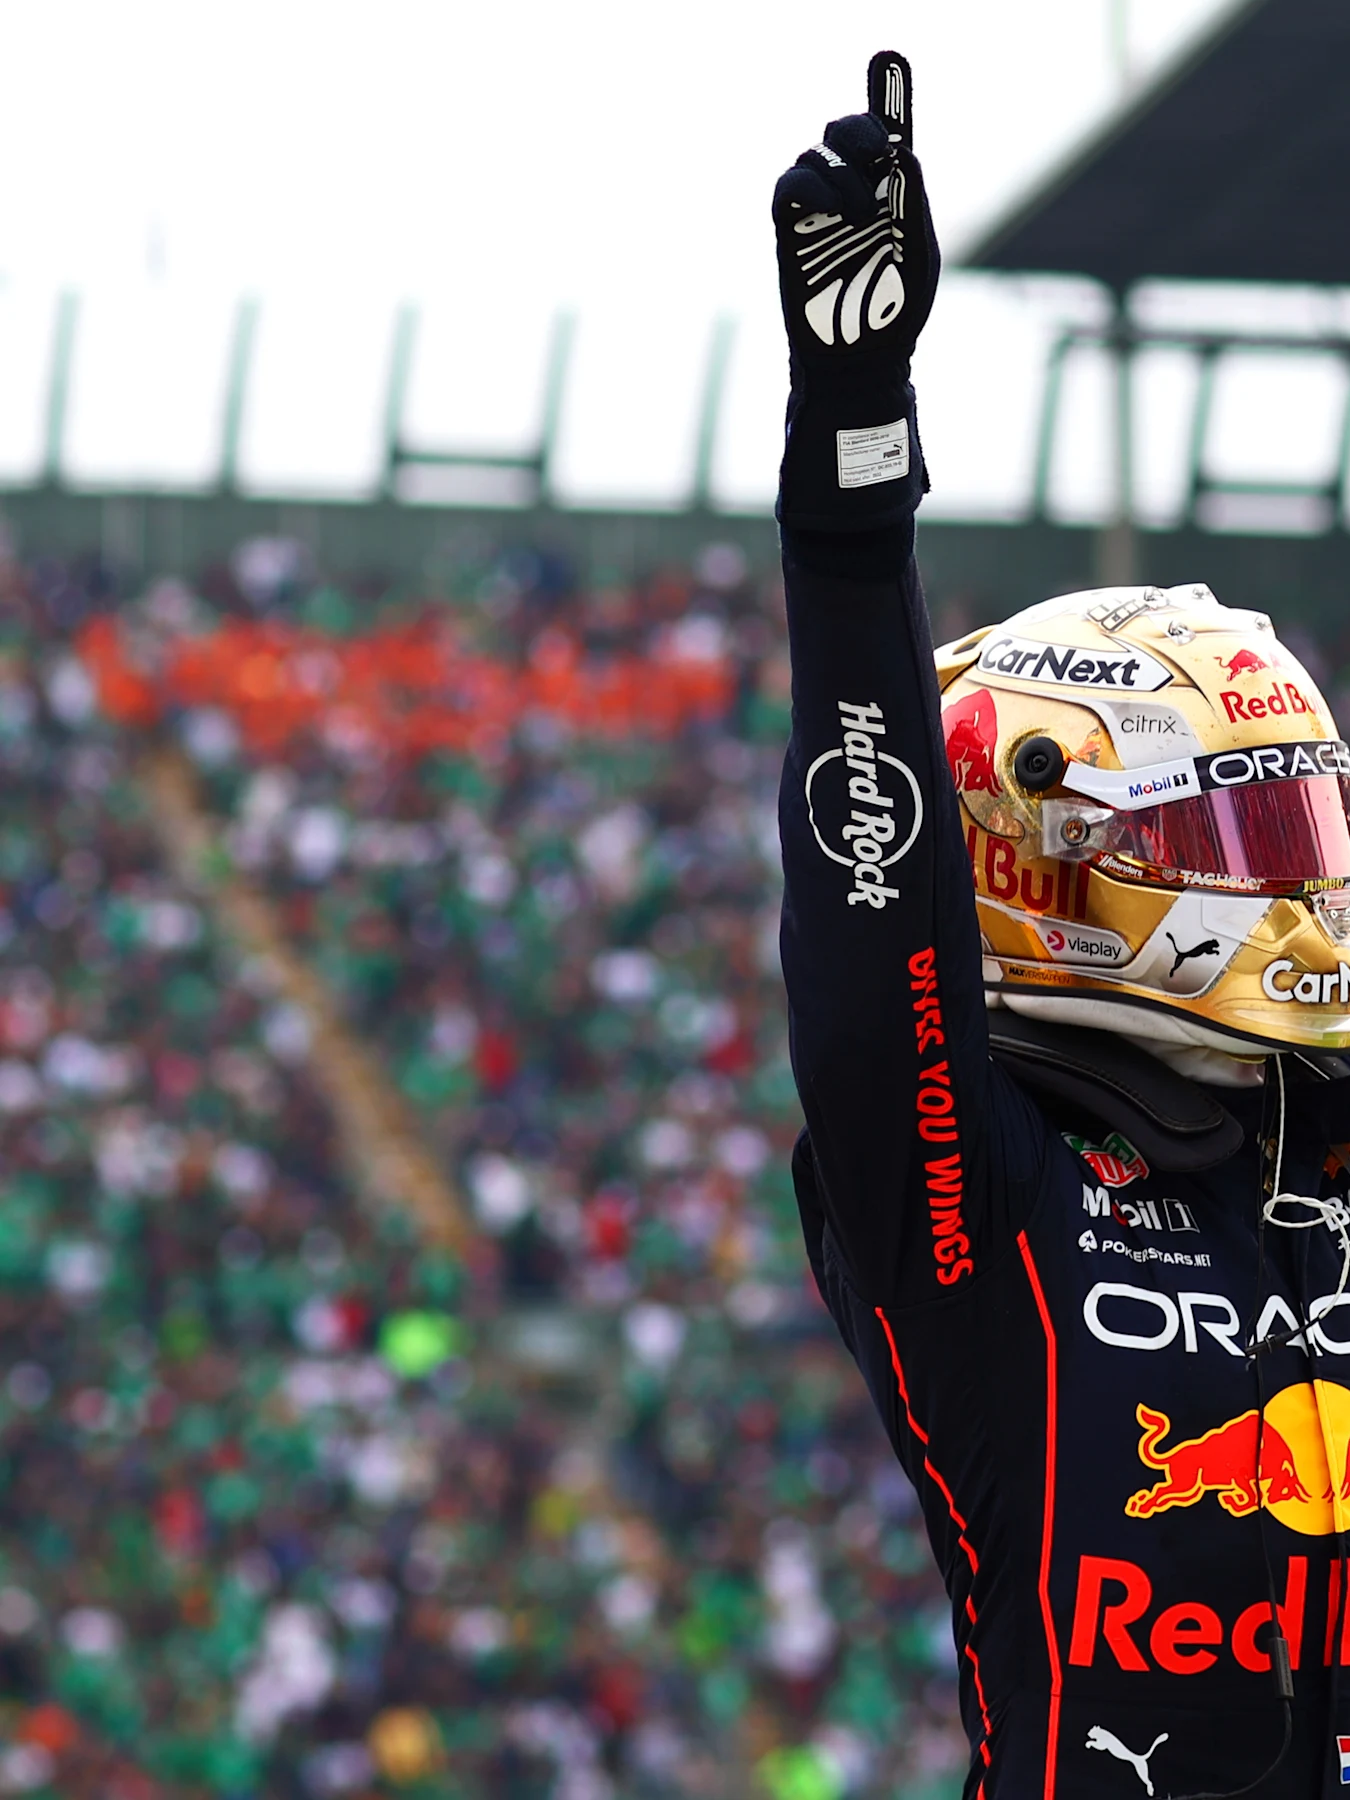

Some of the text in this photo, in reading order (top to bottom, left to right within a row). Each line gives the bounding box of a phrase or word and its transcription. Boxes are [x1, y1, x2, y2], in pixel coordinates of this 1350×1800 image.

[982, 639, 1140, 686] CarNext
[1121, 715, 1176, 735] citrix
[1220, 682, 1288, 723] Red
[838, 701, 900, 909] Hard Rock
[1128, 777, 1171, 798] Mobil
[985, 834, 1091, 919] Bull
[1068, 937, 1121, 960] viaplay
[917, 1060, 958, 1142] YOU
[925, 1153, 973, 1285] WINGS
[1068, 1555, 1307, 1675] Red
